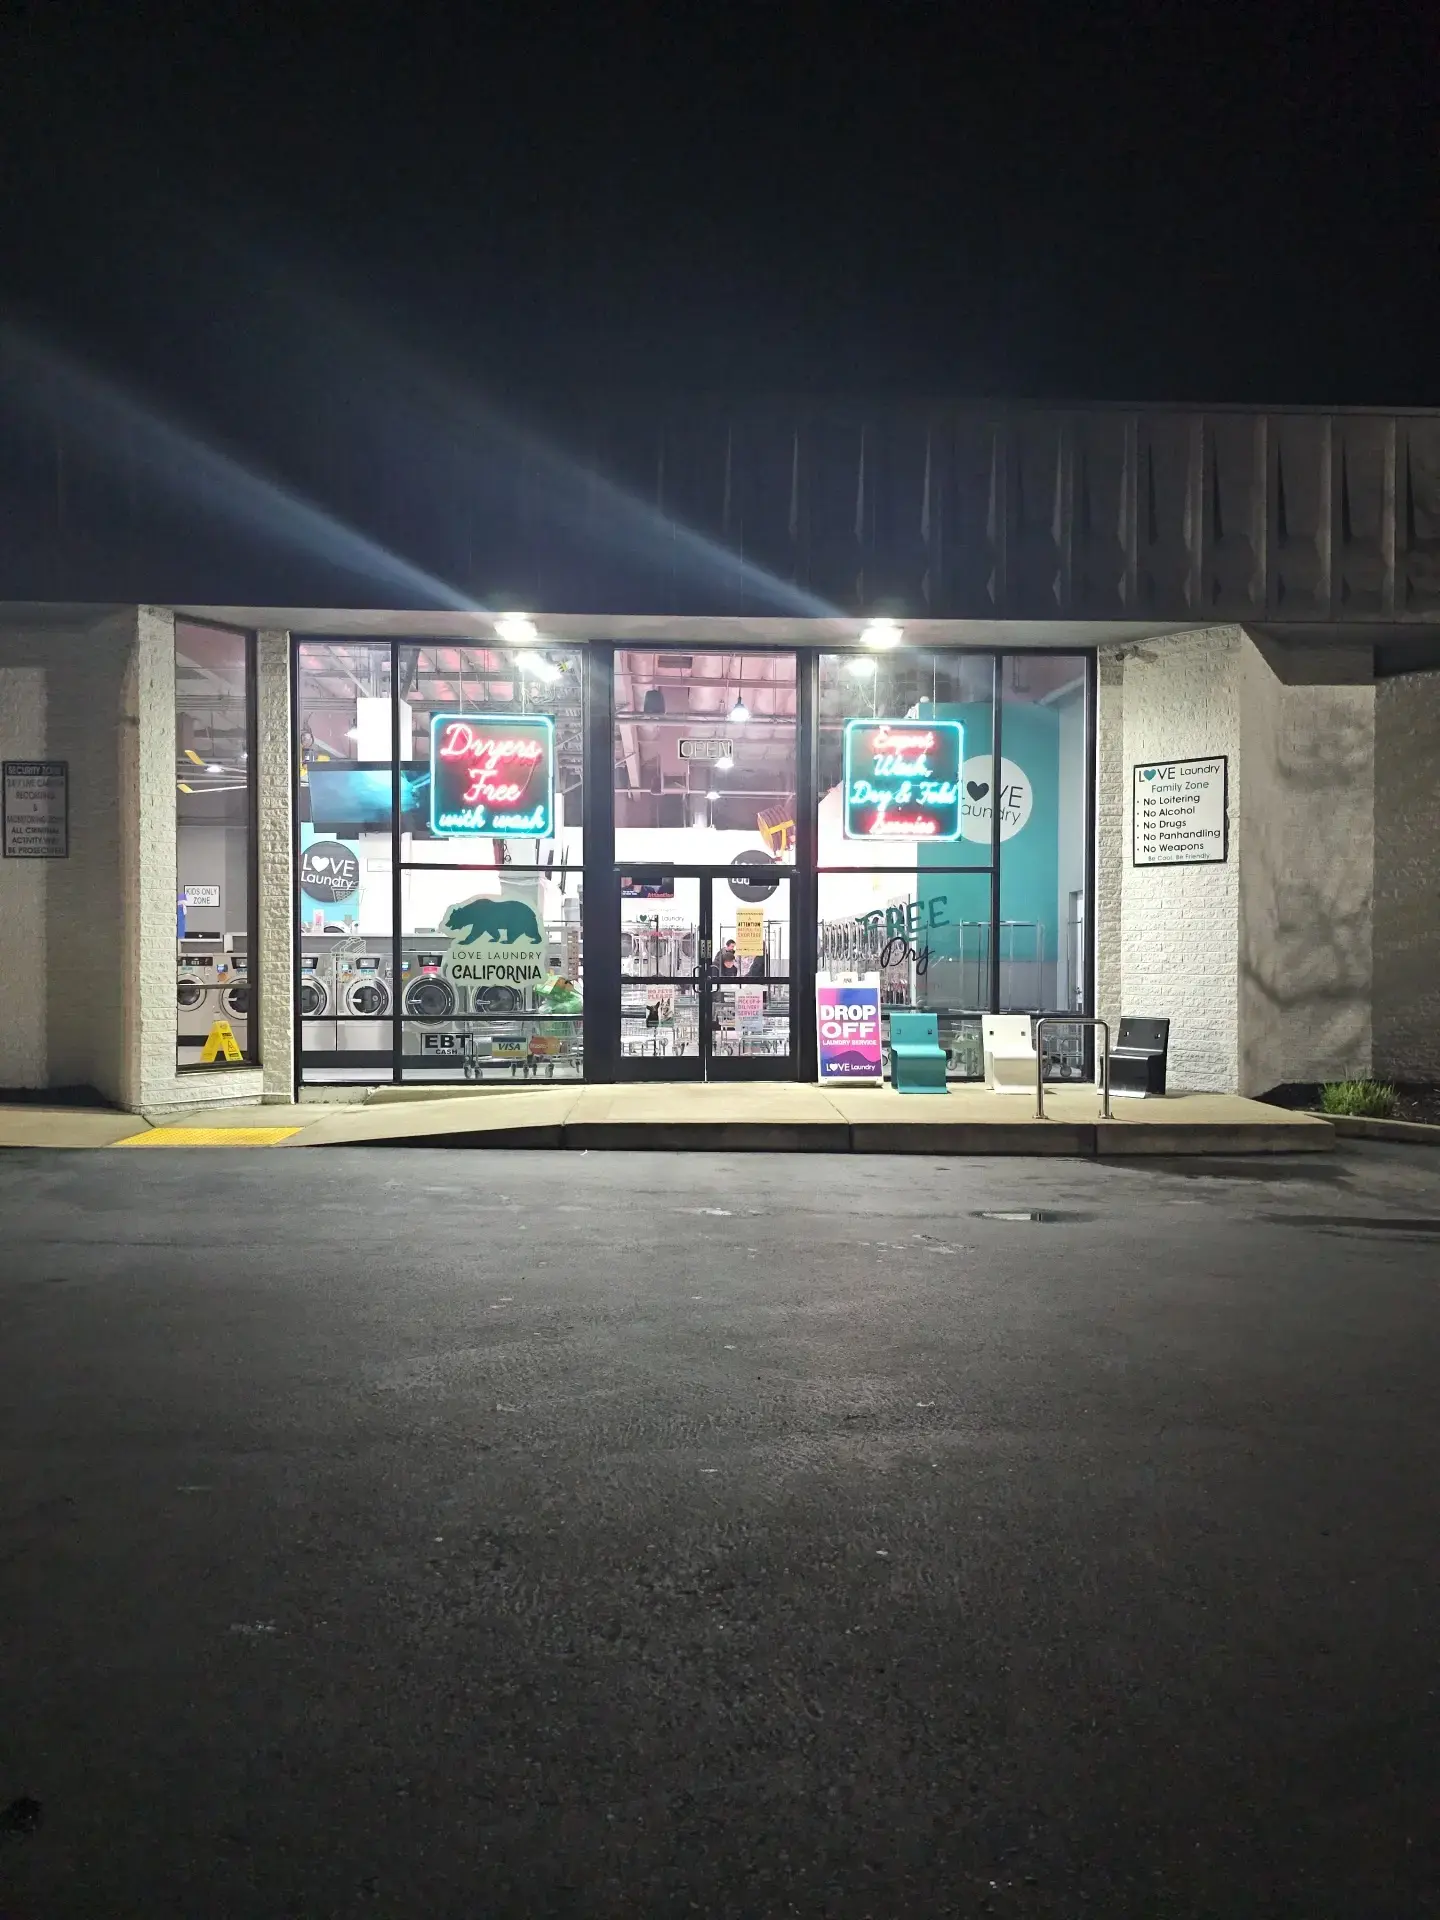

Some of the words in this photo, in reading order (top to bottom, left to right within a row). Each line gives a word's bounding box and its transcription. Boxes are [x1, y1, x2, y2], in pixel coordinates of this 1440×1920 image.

[440, 723, 543, 770] Dryers
[680, 740, 731, 758] OPEN
[1180, 764, 1220, 776] Laundry
[463, 768, 521, 801] Free
[1151, 782, 1183, 793] Family
[1185, 781, 1209, 790] Zone
[849, 780, 892, 815] Dry
[1143, 798, 1157, 806] No
[1159, 794, 1201, 804] Loitering
[439, 804, 486, 828] with
[492, 804, 545, 829] wash
[962, 801, 1022, 826] aundry
[1143, 809, 1157, 818] No
[1158, 806, 1196, 817] Alcohol
[1143, 821, 1157, 830] No
[1159, 820, 1187, 830] Drugs
[1143, 833, 1157, 841] No
[1159, 829, 1221, 840] Panhandling
[1143, 845, 1157, 853] No
[1158, 842, 1205, 853] Weapons
[300, 870, 354, 891] Laundry
[186, 887, 200, 896] KIDS
[201, 887, 218, 896] ONLY
[193, 896, 211, 905] ZONE
[855, 895, 950, 943] FREE
[452, 951, 482, 960] LOVE
[487, 951, 542, 960] LAUNDRY
[880, 936, 936, 976] Dry
[451, 964, 542, 984] CALIFORNIA
[820, 1004, 877, 1021] DROP
[821, 1021, 877, 1039] OFF
[424, 1035, 471, 1049] EBT
[497, 1043, 521, 1051] VISA
[850, 1063, 876, 1072] Laundry
